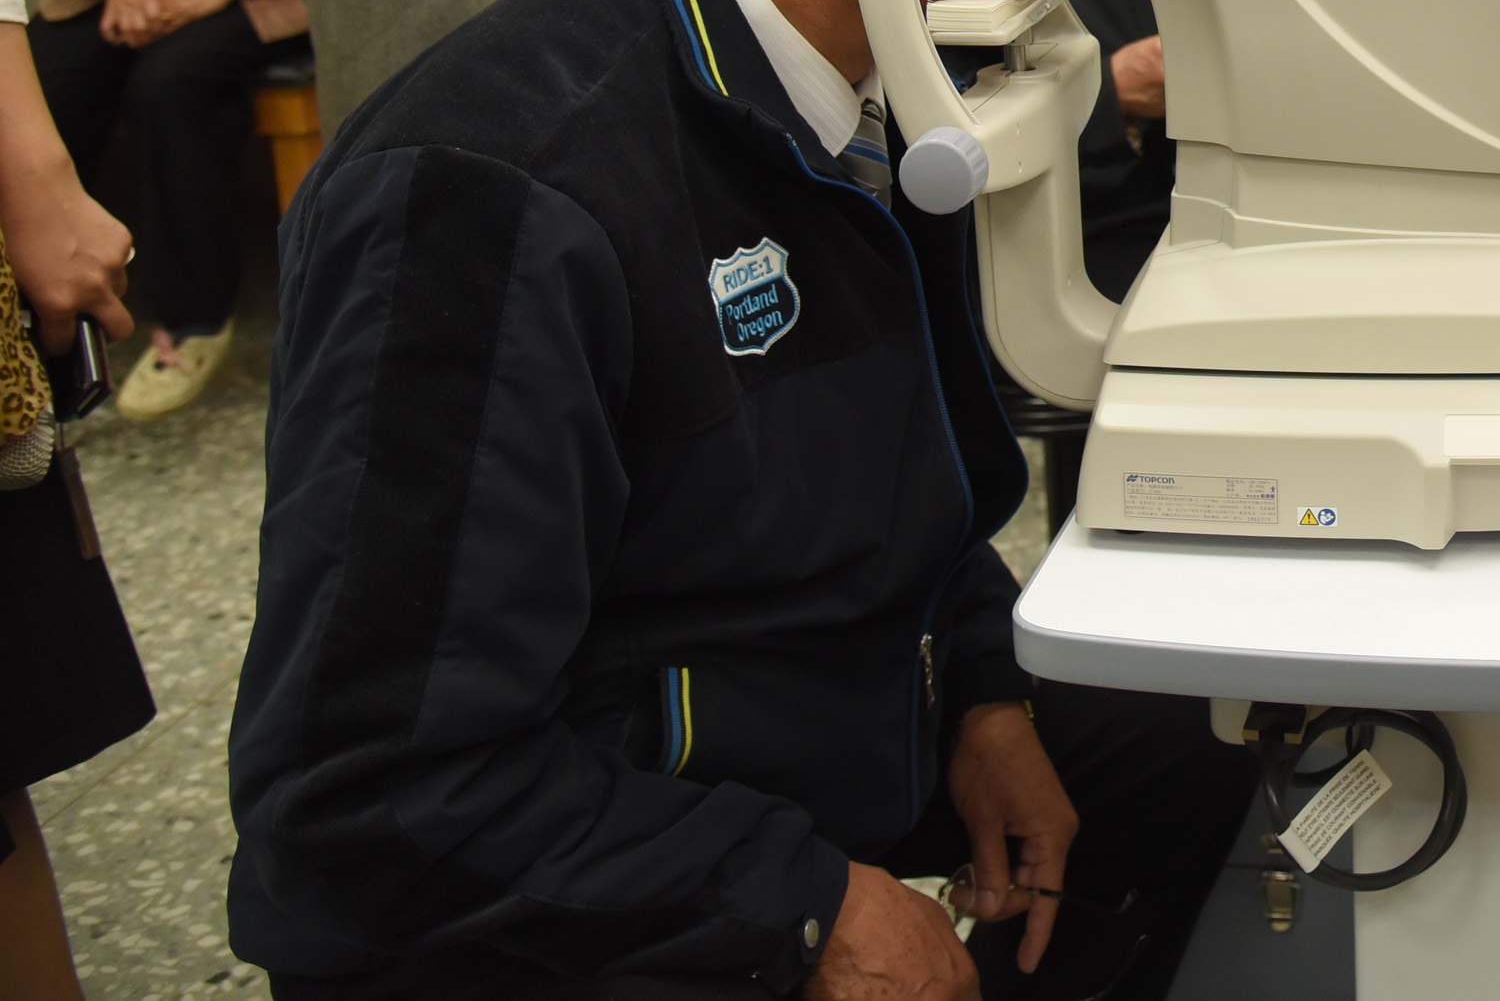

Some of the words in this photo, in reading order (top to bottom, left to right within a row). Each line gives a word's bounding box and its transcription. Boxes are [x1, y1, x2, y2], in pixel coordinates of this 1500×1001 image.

[722, 255, 774, 293] RIDE:1
[725, 283, 779, 325] Portland
[736, 310, 783, 342] Oregon
[1139, 475, 1175, 485] TOPCON
